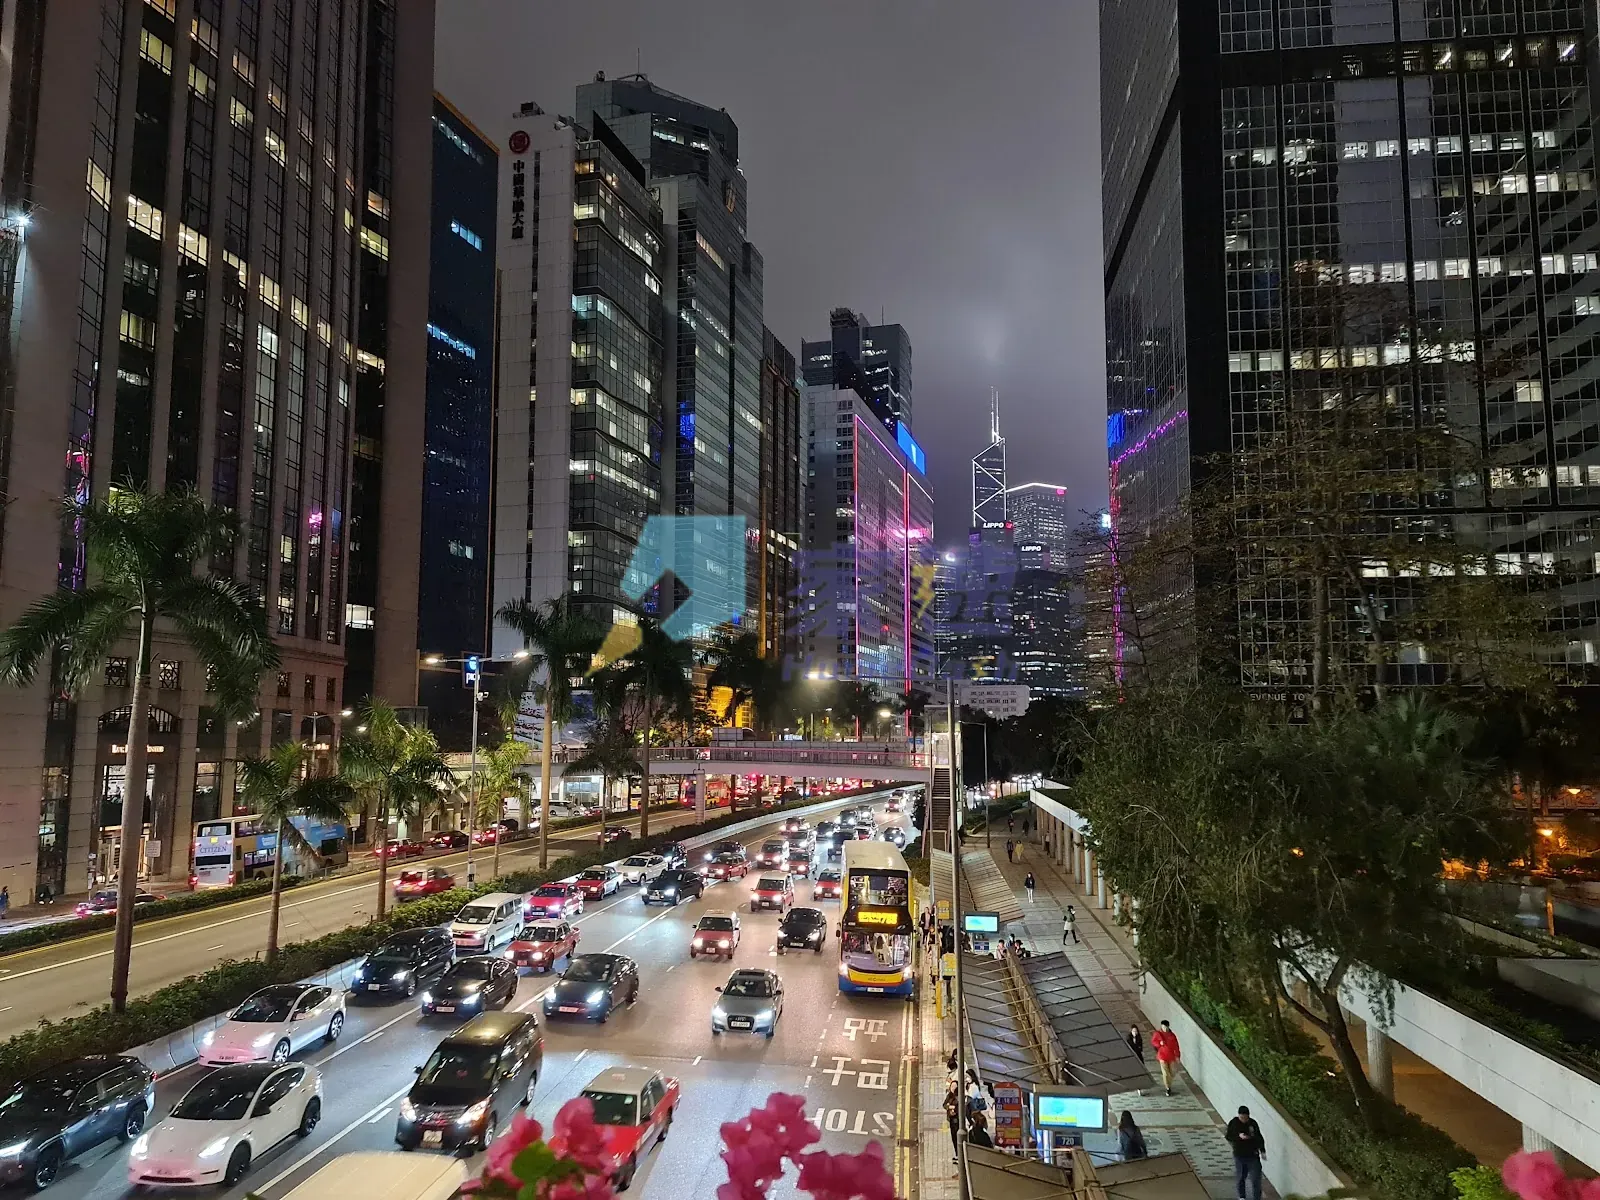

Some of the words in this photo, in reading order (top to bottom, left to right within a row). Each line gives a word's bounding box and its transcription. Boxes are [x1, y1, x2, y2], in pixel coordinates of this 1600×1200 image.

[199, 845, 227, 854] CITIZEN
[842, 1017, 889, 1043] 站
[822, 1056, 891, 1090] 巴士
[1061, 1136, 1075, 1146] 720
